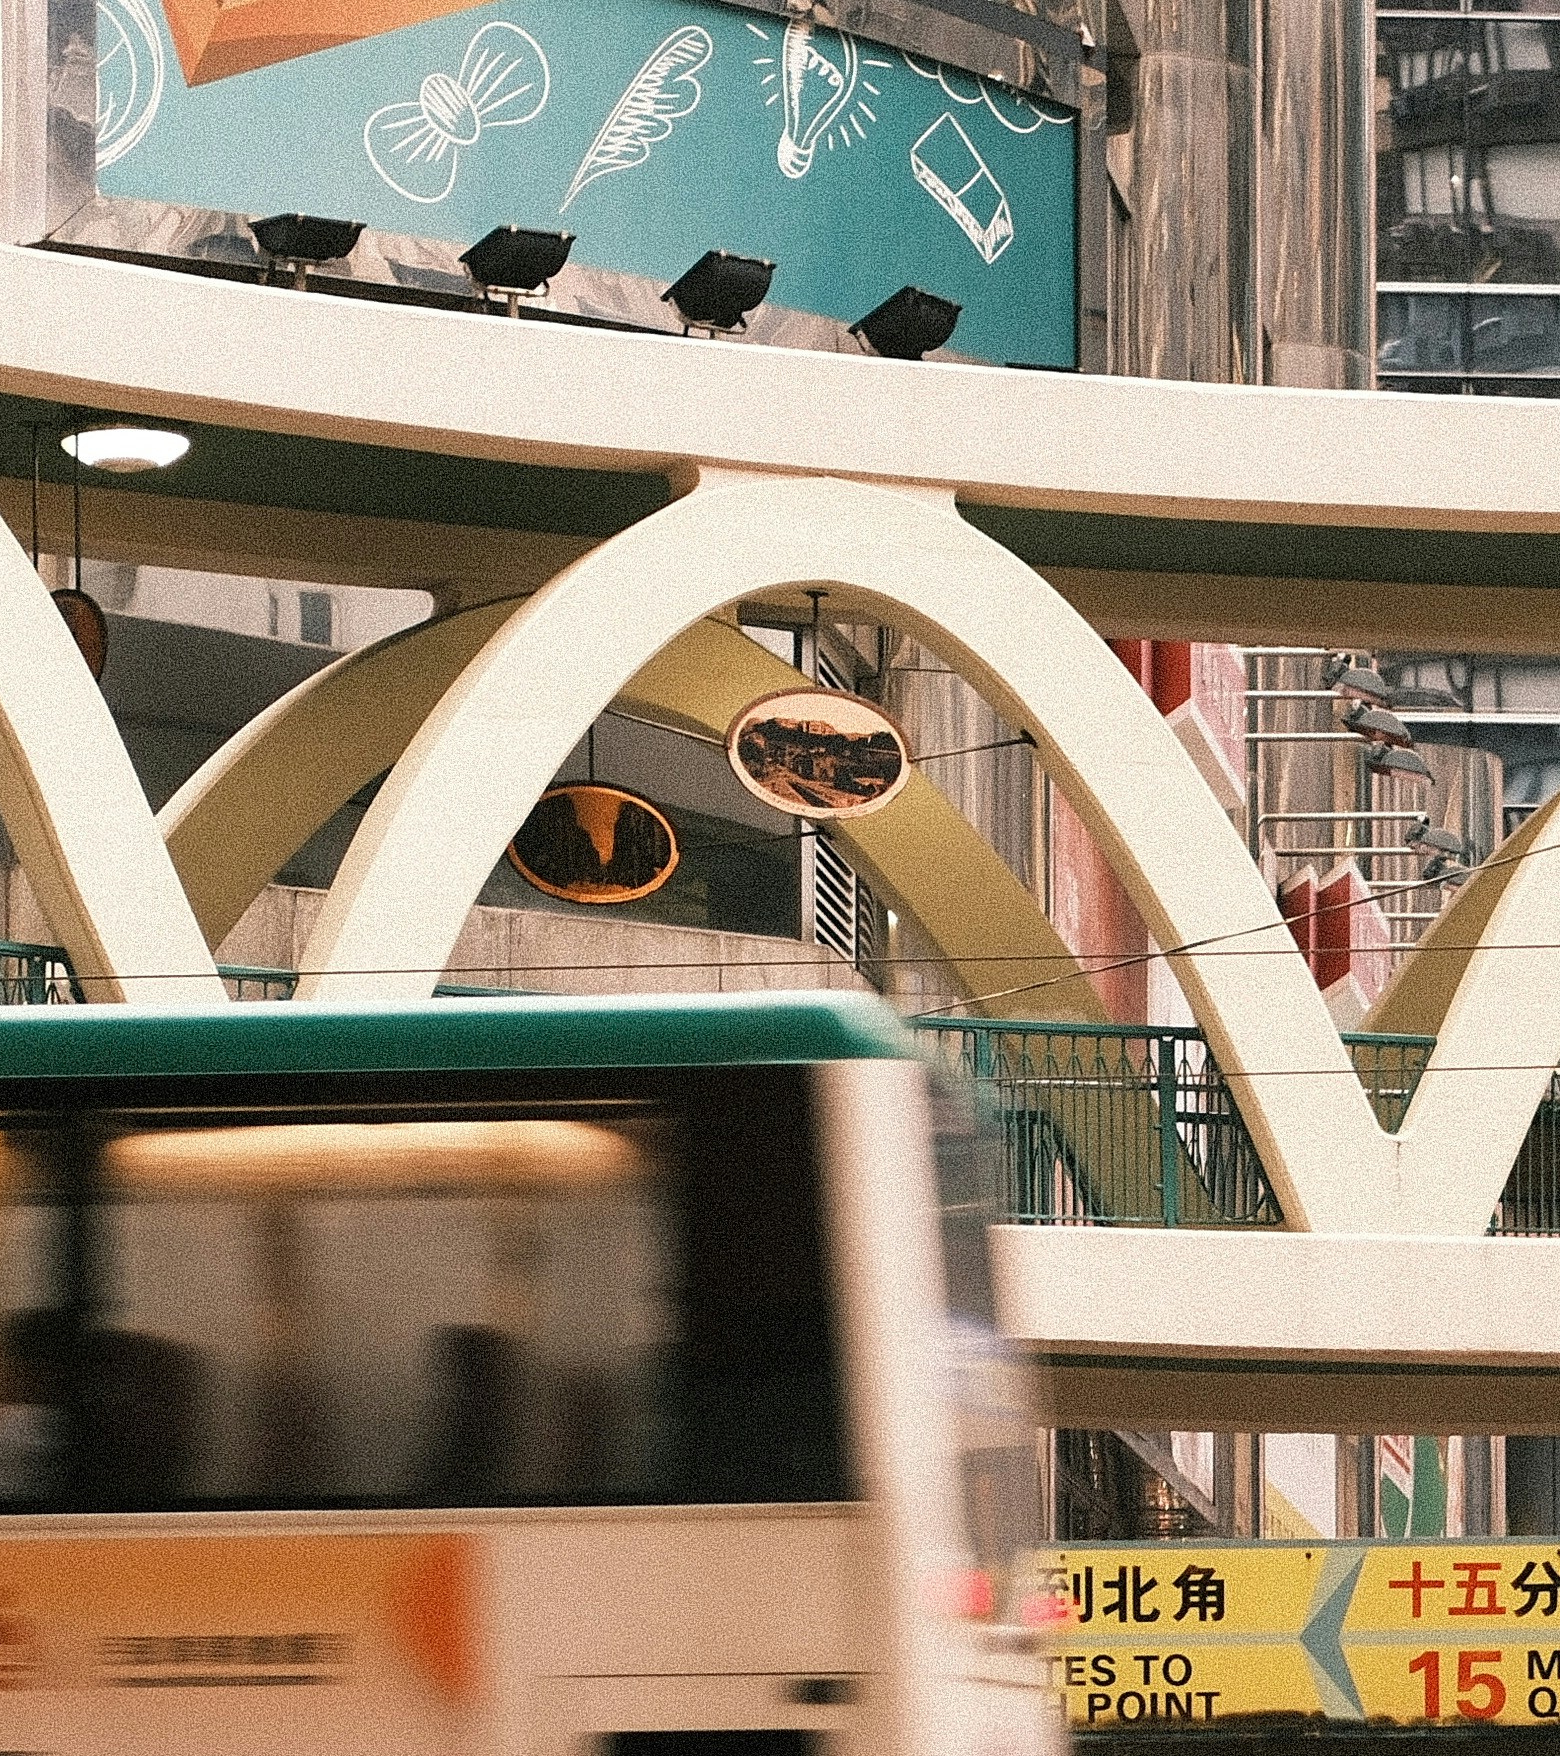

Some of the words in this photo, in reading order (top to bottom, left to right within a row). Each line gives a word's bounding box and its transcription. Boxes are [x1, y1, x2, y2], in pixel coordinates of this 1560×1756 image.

[1133, 1653, 1193, 1686] TO
[1408, 1650, 1507, 1719] 15
[1087, 1691, 1221, 1724] POINT
